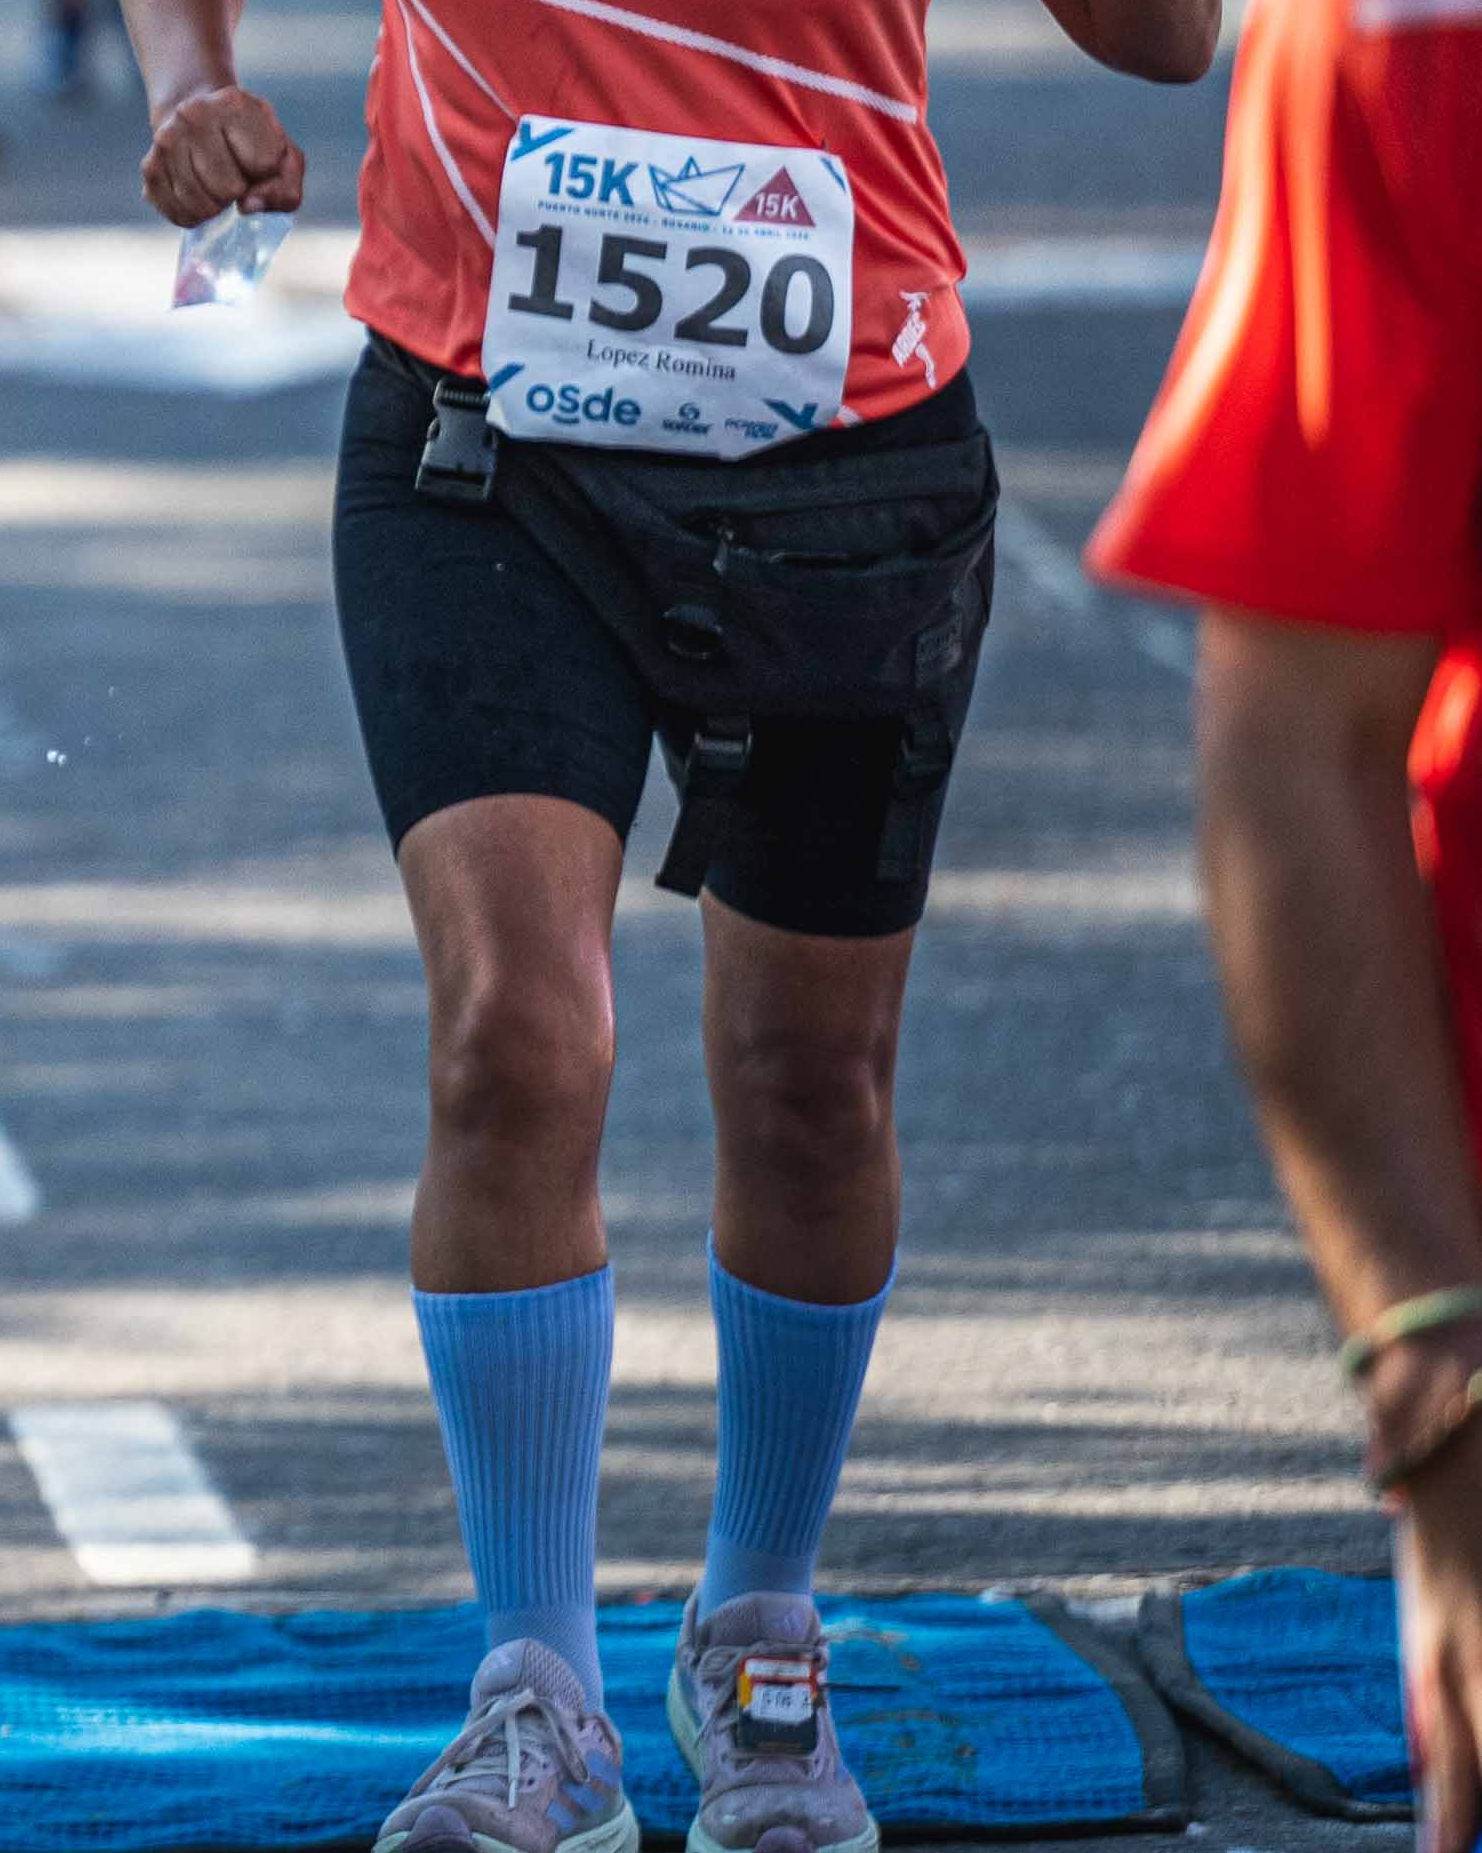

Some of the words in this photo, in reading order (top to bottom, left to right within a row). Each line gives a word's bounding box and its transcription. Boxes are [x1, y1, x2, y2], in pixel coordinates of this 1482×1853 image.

[544, 151, 639, 208] 15K
[756, 193, 799, 220] 15K
[508, 223, 835, 355] 1520
[586, 339, 650, 369] Lopez
[656, 350, 737, 381] Romina
[526, 383, 641, 426] osde
